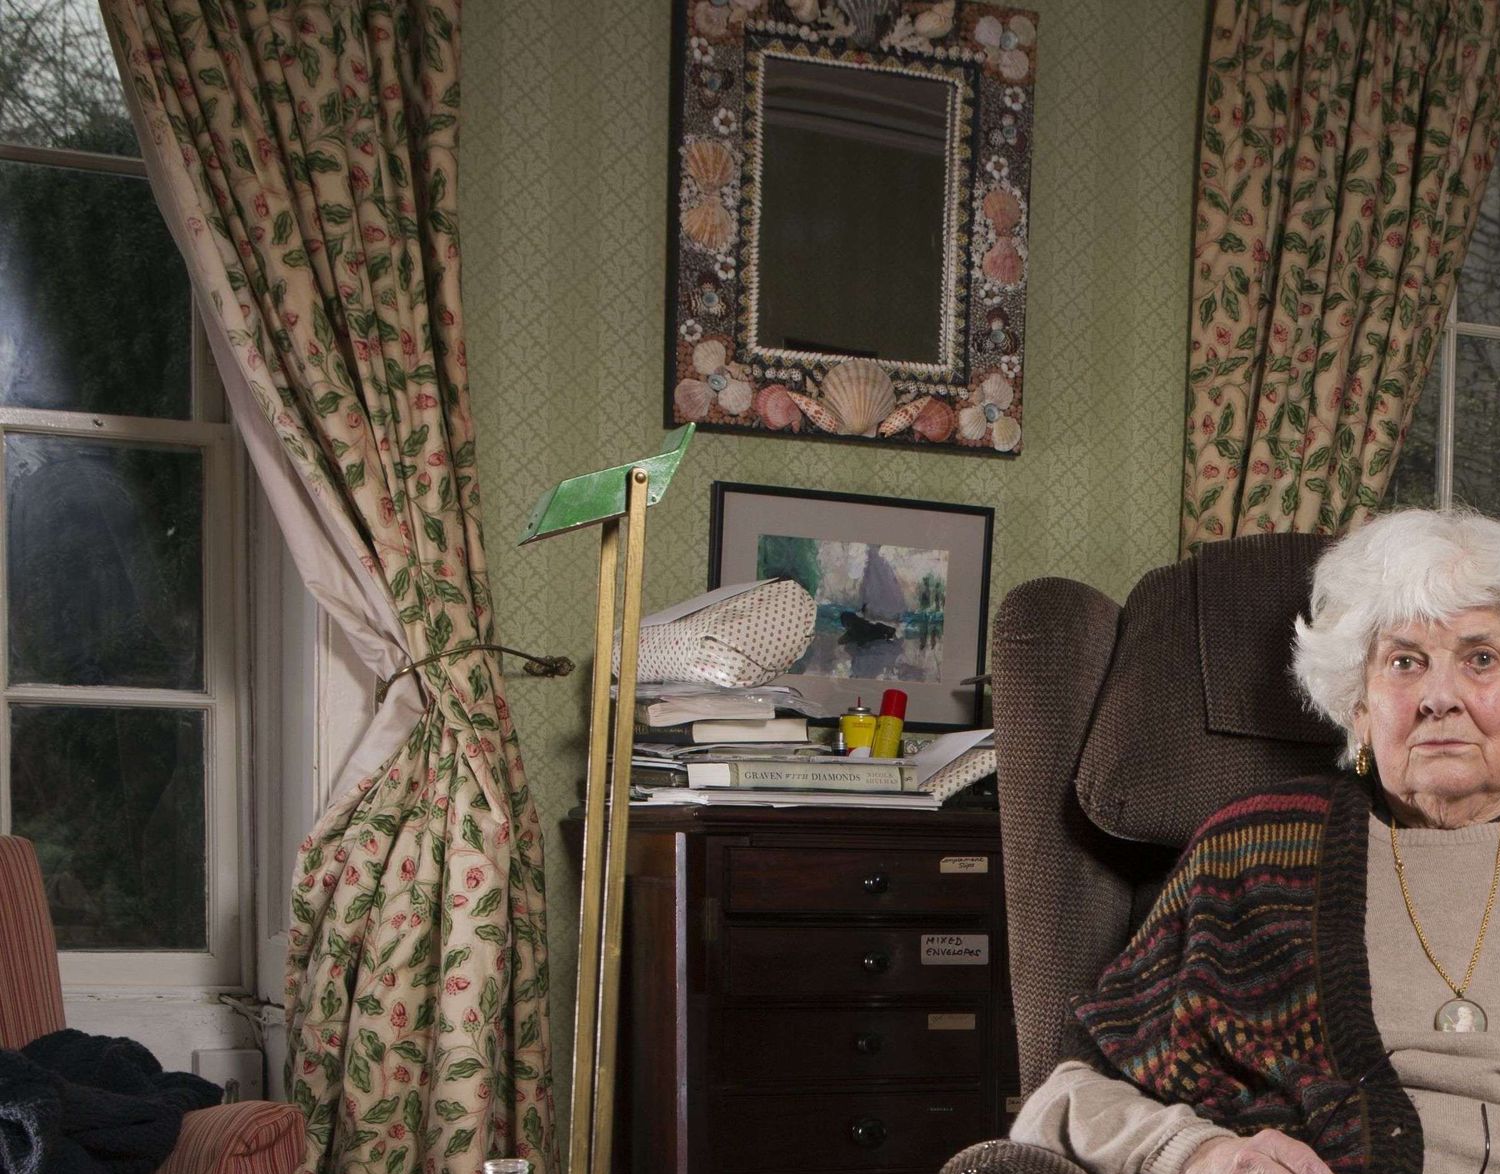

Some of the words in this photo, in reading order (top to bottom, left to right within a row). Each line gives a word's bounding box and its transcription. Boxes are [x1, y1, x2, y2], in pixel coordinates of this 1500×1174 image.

[744, 771, 783, 781] GRAVEN
[811, 772, 861, 783] DIAMONDS
[926, 937, 963, 946] MIXED
[926, 947, 982, 957] ENVELOPES
